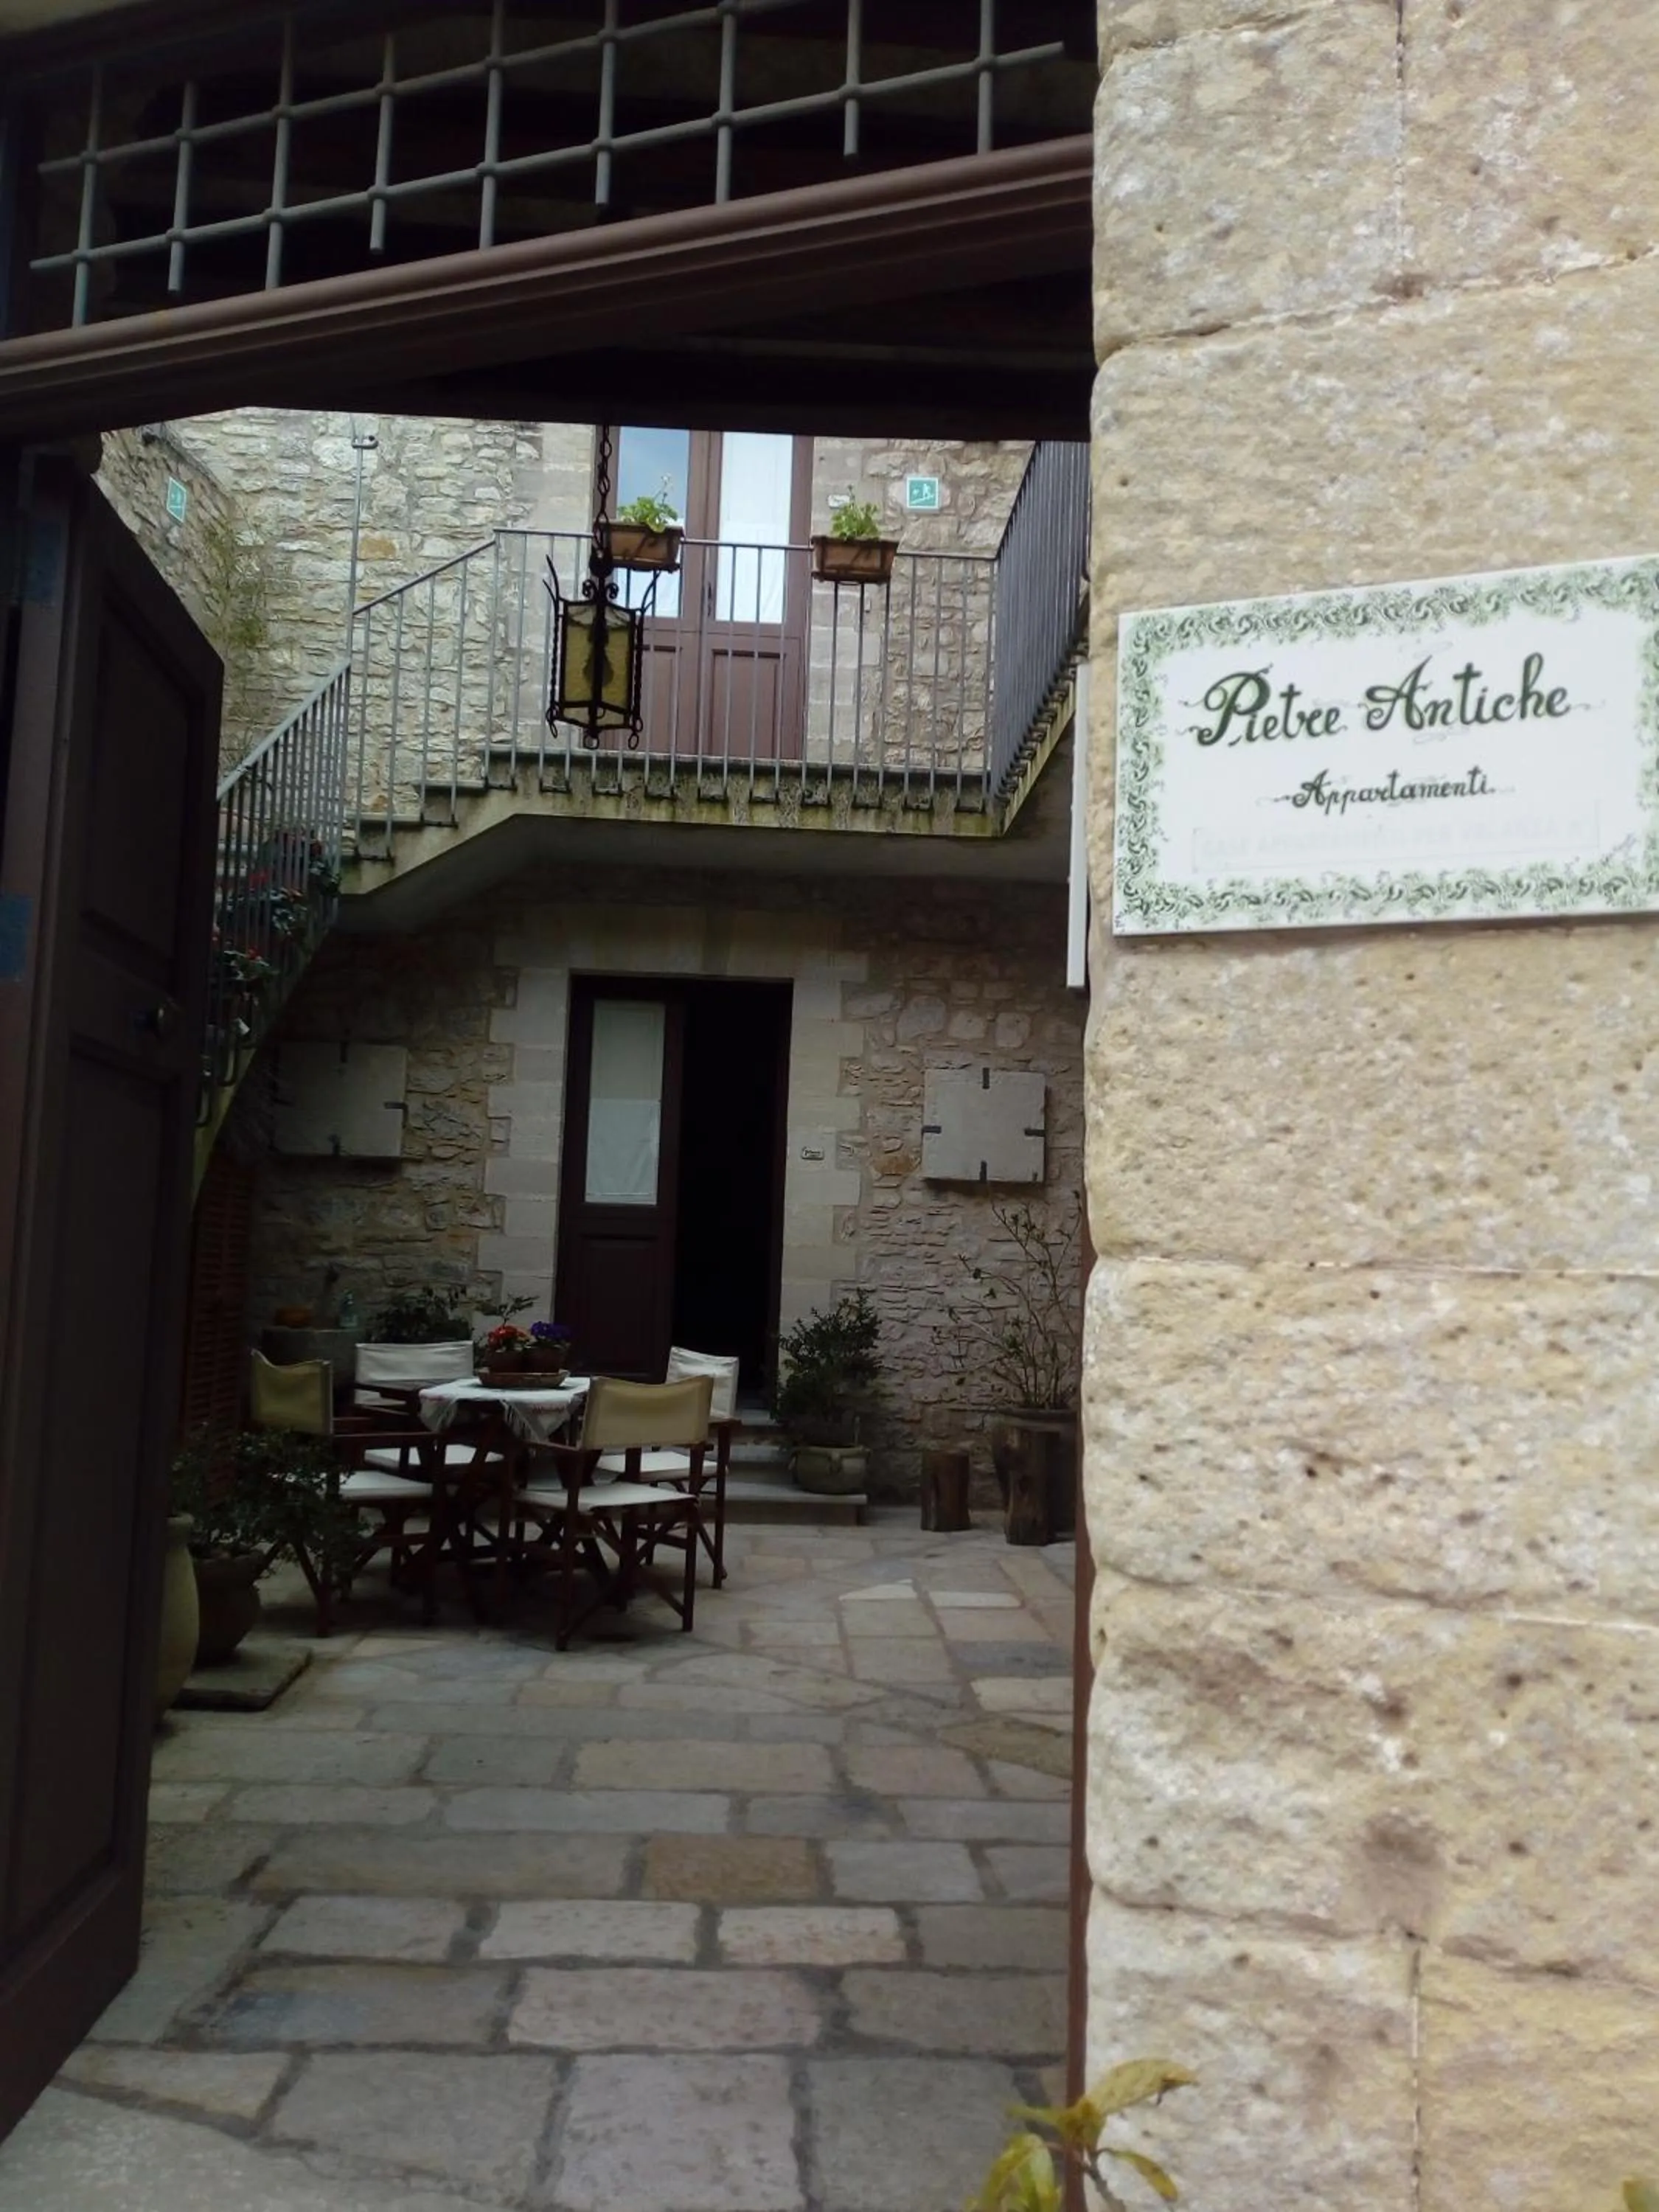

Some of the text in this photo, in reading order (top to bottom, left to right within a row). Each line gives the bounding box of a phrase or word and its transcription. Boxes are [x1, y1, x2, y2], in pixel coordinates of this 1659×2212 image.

[1189, 652, 1571, 747] Pietre Antiche
[1292, 766, 1487, 815] Appartamenti
